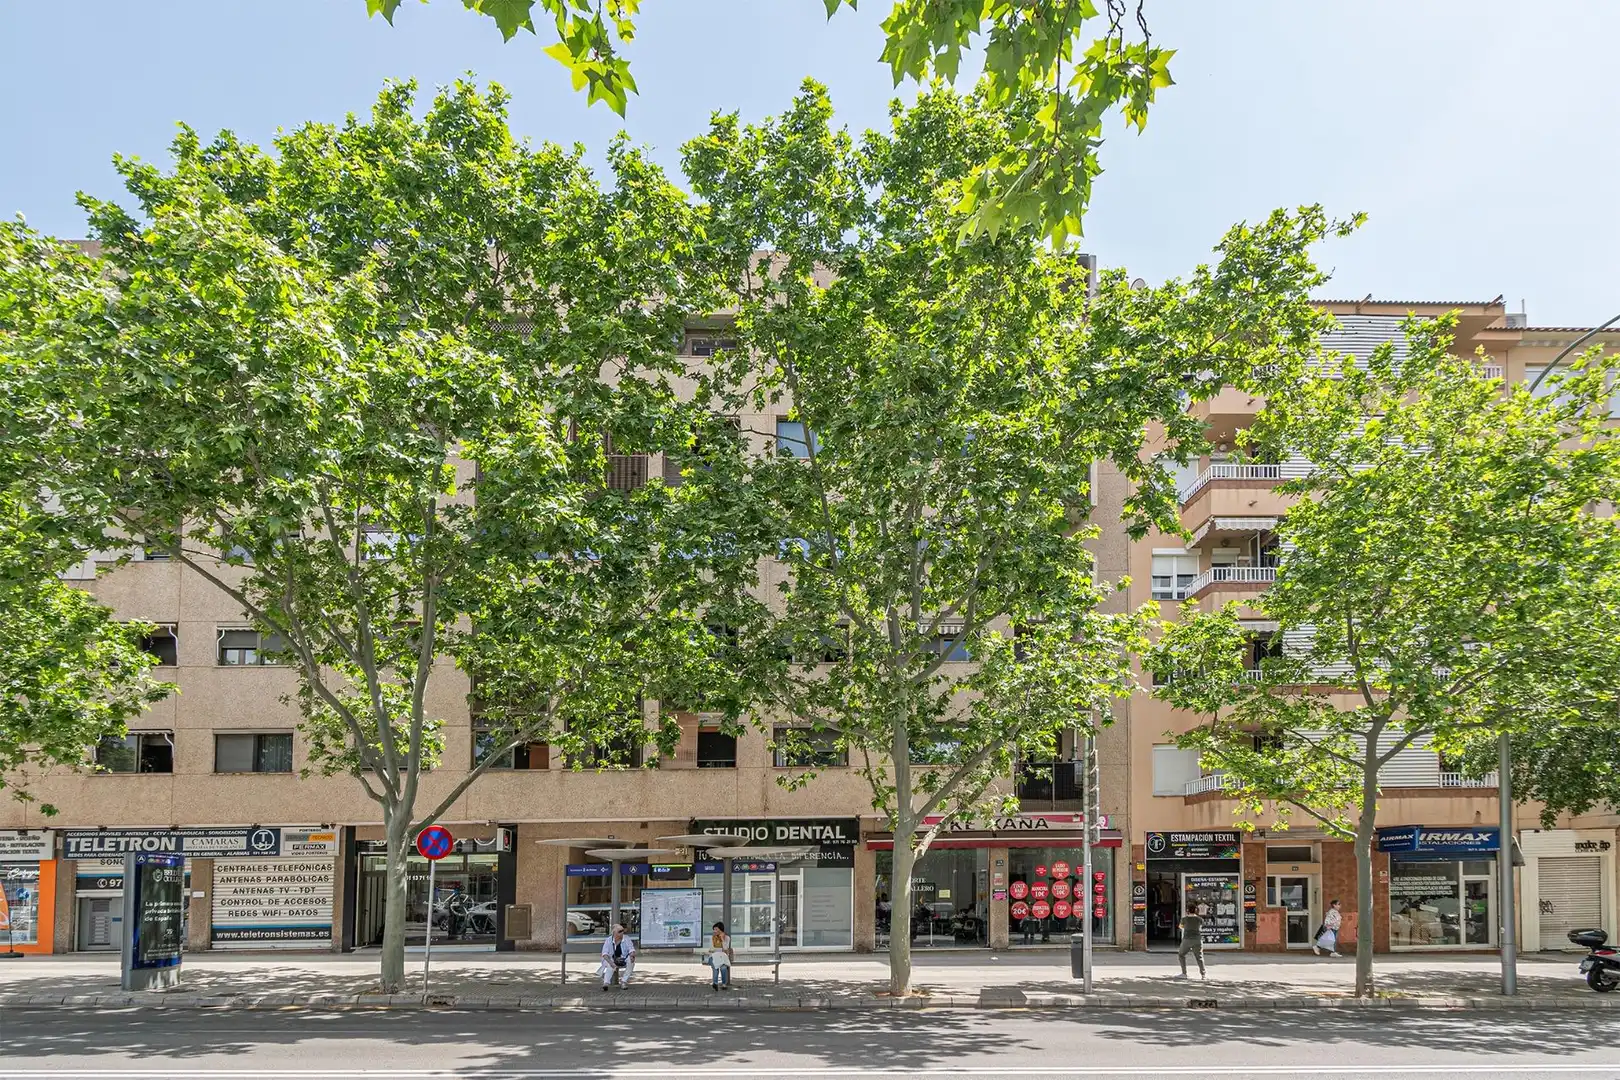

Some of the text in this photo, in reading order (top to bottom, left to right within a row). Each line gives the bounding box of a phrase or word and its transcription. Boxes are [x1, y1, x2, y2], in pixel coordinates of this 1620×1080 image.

[703, 826, 846, 841] STUDIO DENTAL
[1170, 833, 1236, 842] ESTAMPACIÓN TEXTIL
[1418, 832, 1493, 841] IRMAX
[66, 837, 177, 852] TELETRON
[217, 863, 333, 872] CENTRALES TELEFÓNICAS
[109, 879, 123, 887] 97
[266, 874, 330, 883] PARABÓLICAS
[220, 898, 264, 906] CONTROL
[284, 897, 327, 905] ACCESOS
[216, 929, 330, 939] www.teletronsistemas.es
